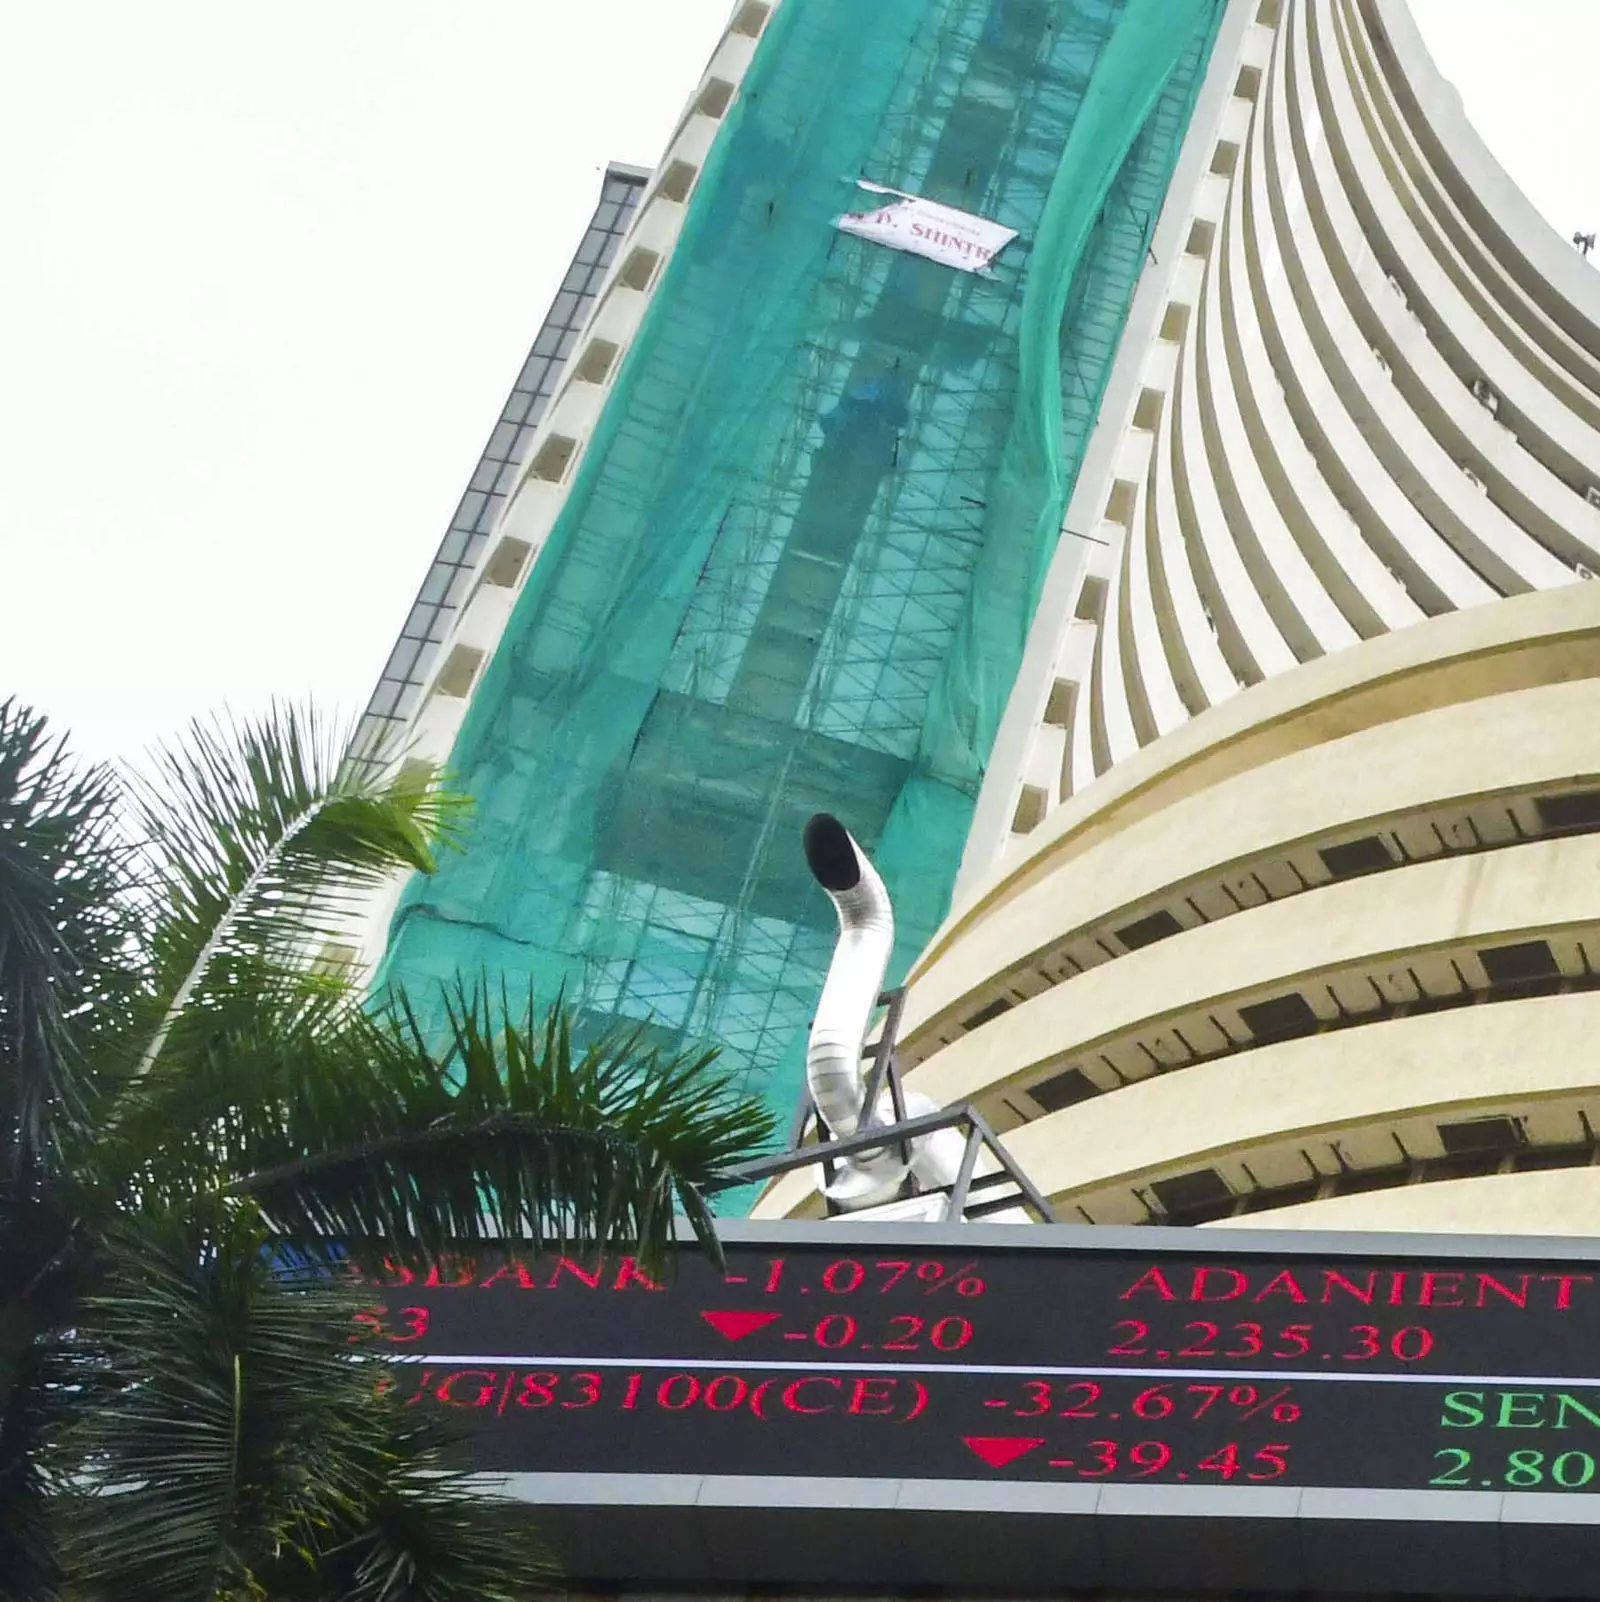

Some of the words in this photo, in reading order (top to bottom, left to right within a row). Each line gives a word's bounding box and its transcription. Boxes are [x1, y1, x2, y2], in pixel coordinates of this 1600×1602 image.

[724, 1257, 986, 1298] -1.07%
[1119, 1266, 1593, 1312] ADANIENT
[784, 1313, 975, 1351] -0.20
[984, 1381, 1302, 1424] -32.67%
[1048, 1438, 1292, 1480] -39.45
[1429, 1448, 1596, 1488] 2.80
